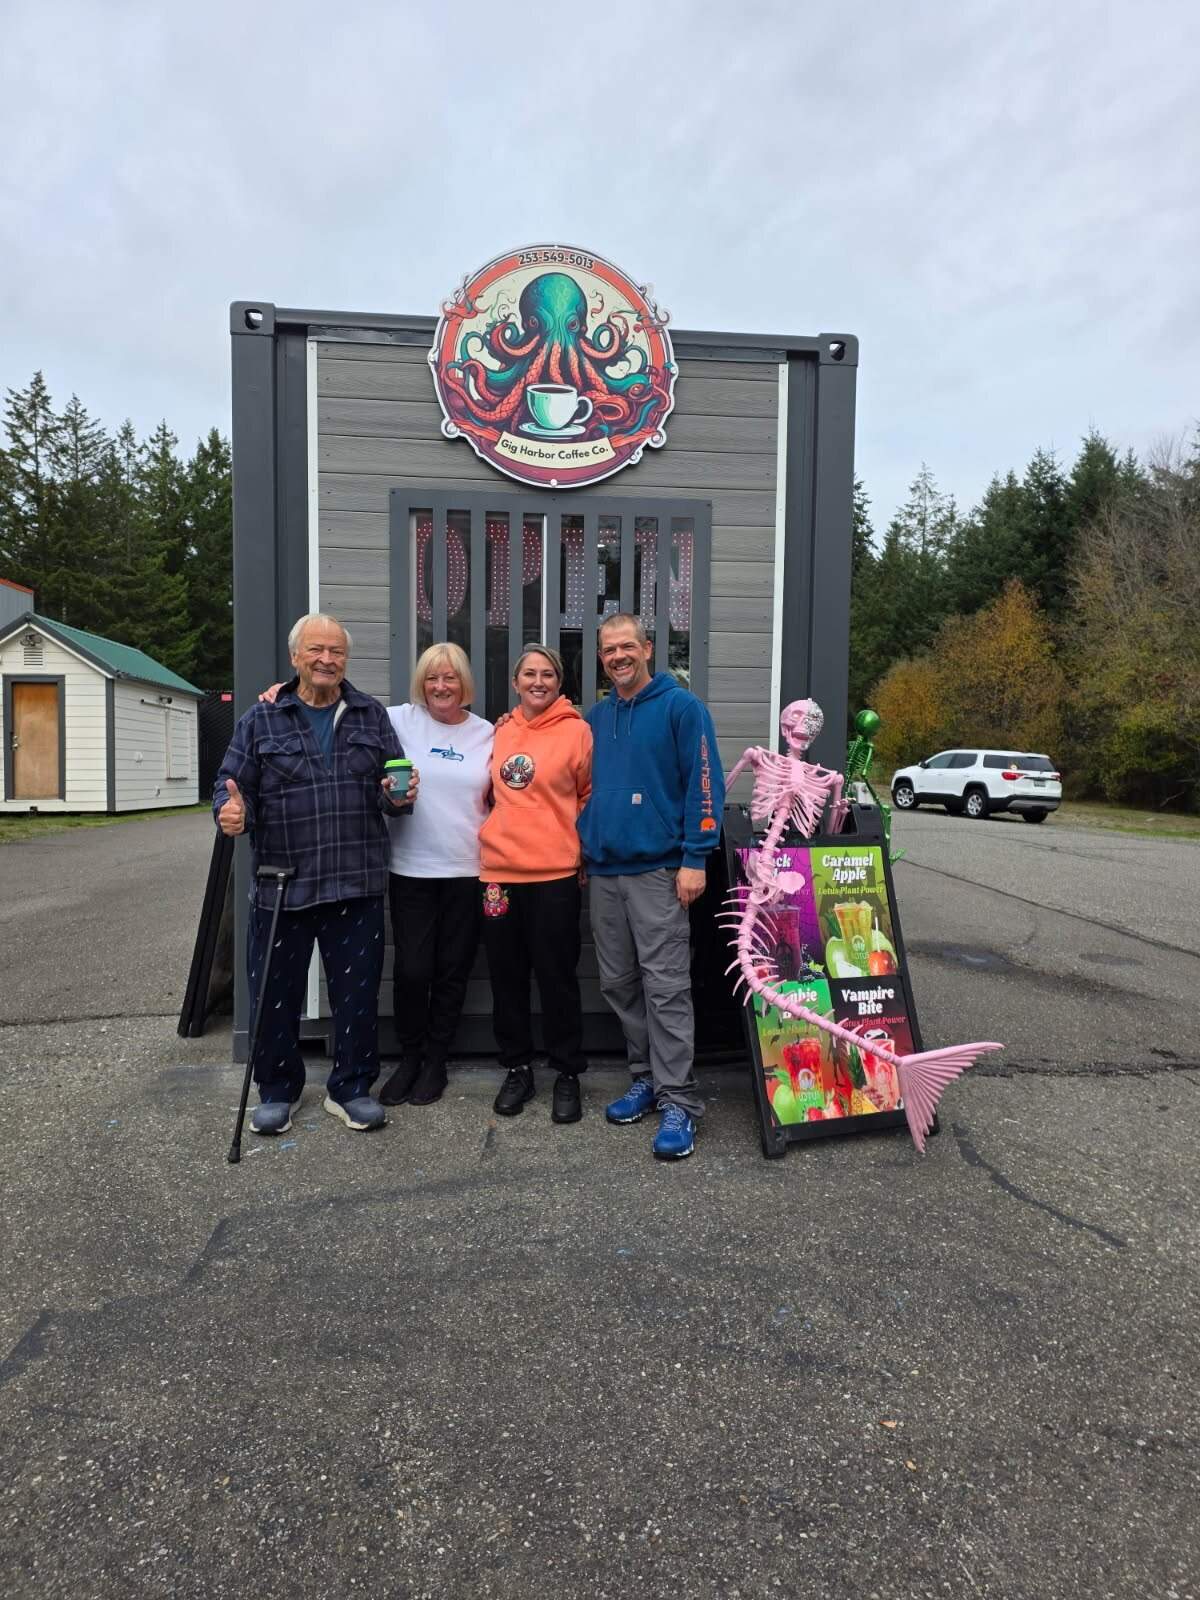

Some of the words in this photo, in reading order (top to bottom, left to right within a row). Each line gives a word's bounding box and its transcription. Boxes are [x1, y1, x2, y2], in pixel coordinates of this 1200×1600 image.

[518, 251, 594, 269] 253-549-5013
[501, 439, 518, 454] Gig
[520, 445, 555, 459] Harbor
[558, 449, 590, 460] Coffee
[592, 445, 609, 455] Co.
[701, 734, 713, 816] carhartt
[822, 852, 874, 867] Caramel
[832, 867, 867, 884] Apple
[841, 985, 895, 1002] Vampire
[858, 1000, 883, 1015] Bite
[841, 1019, 862, 1028] otus
